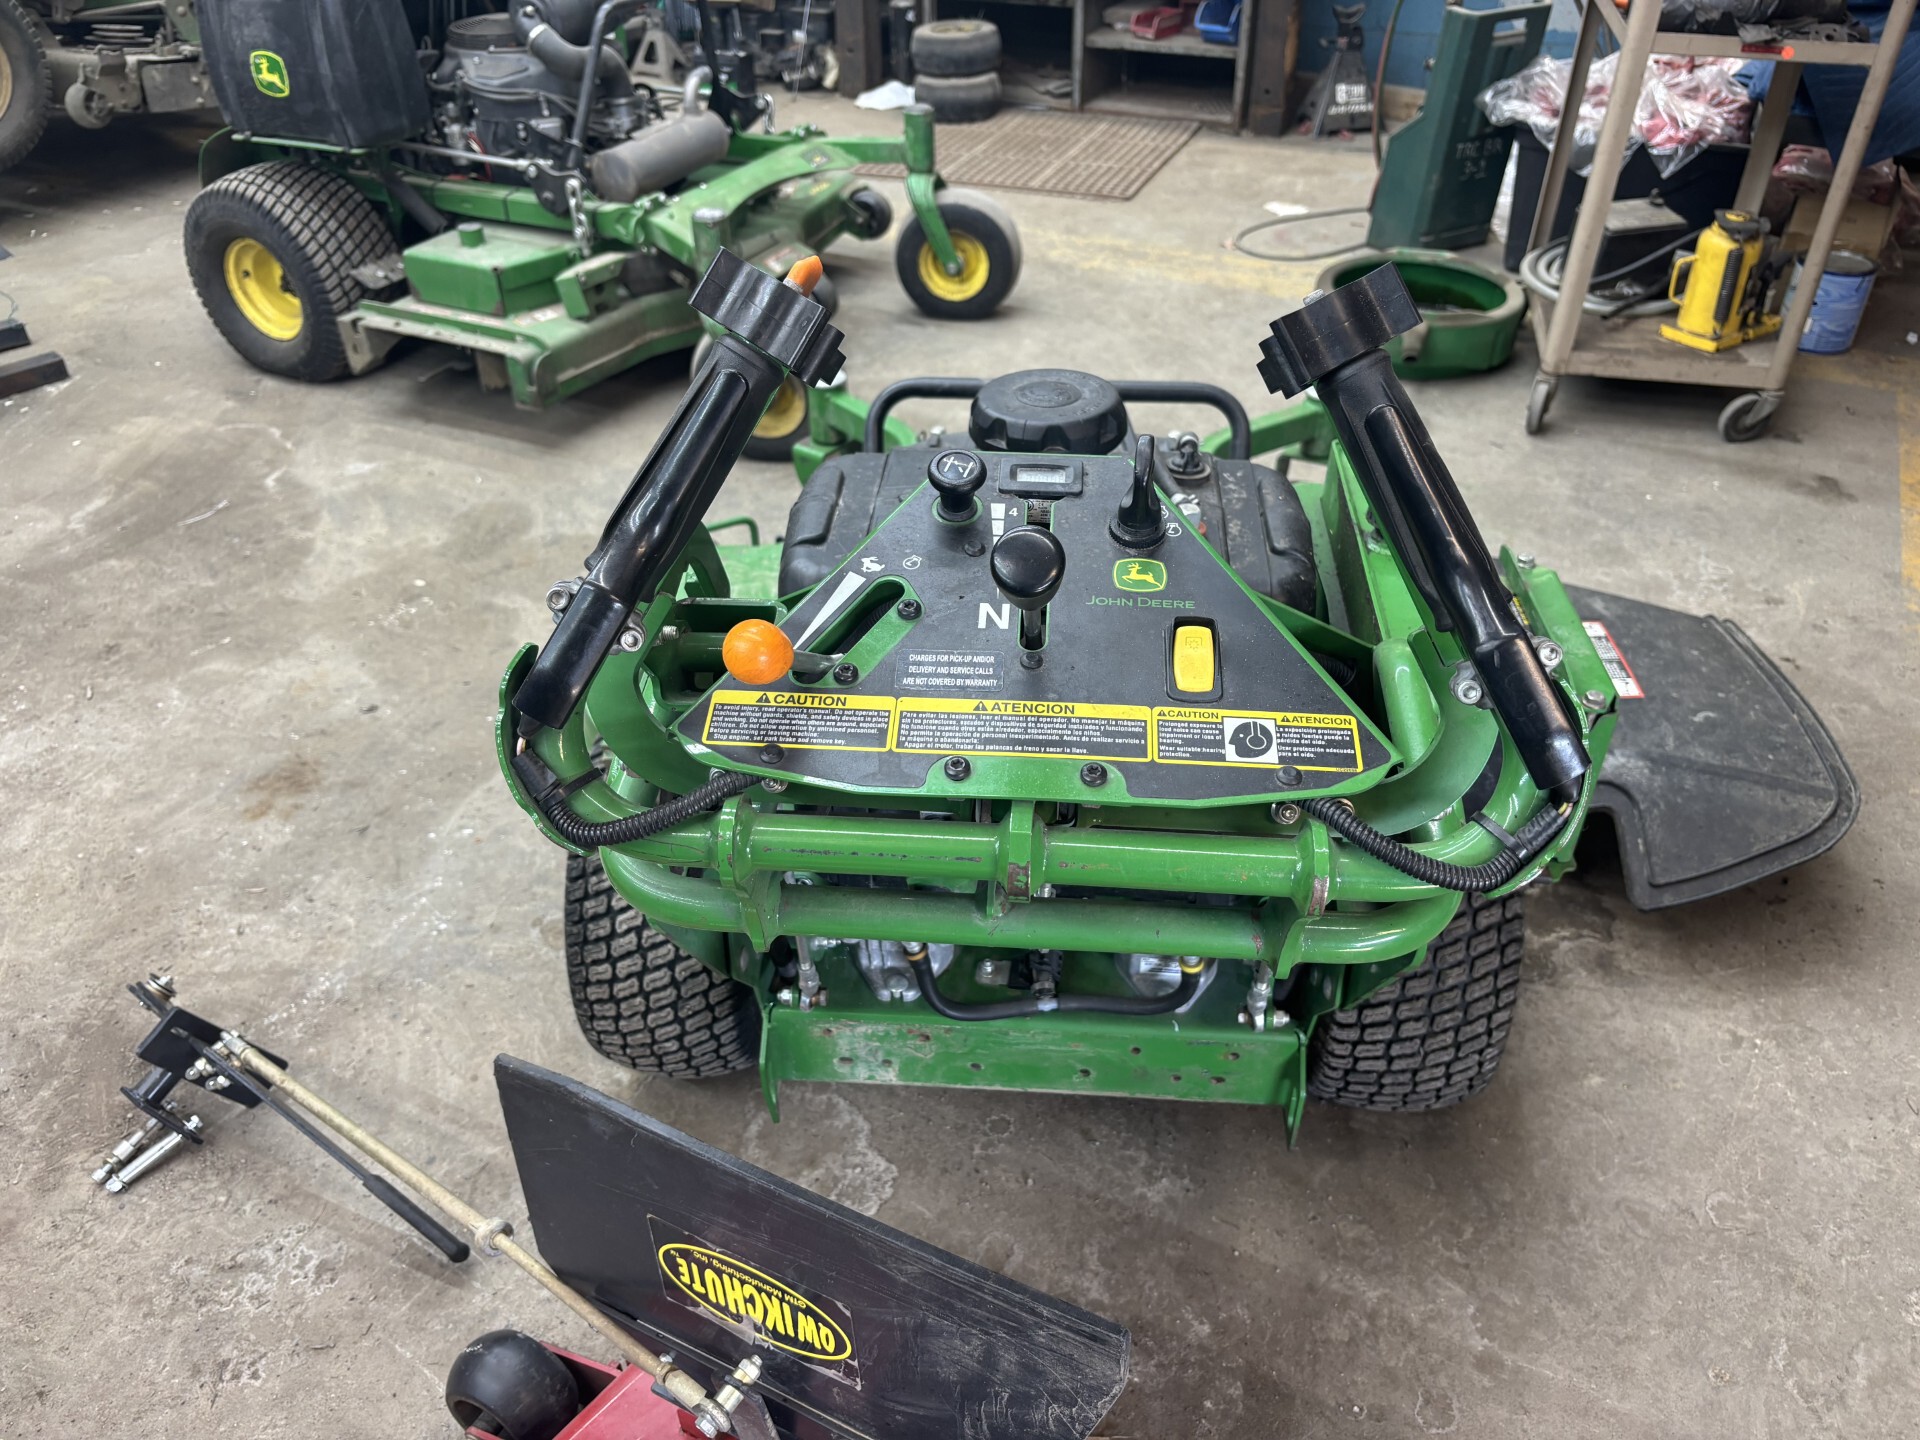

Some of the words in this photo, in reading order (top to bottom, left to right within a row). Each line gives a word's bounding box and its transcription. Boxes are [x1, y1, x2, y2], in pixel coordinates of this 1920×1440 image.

[1009, 507, 1018, 516] 4
[1086, 595, 1133, 606] JOHN
[1138, 597, 1195, 608] DEERE
[978, 602, 1011, 629] N
[909, 653, 937, 662] CHARGES
[937, 654, 949, 662] FOR
[950, 654, 972, 663] PICK-UP
[908, 665, 935, 673] DELIVERY
[936, 666, 949, 674] AND
[950, 666, 974, 674] SERVICE
[974, 667, 993, 675] CALLS
[902, 677, 914, 685] ARE
[915, 677, 928, 685] NOT
[928, 678, 955, 686] COVERED
[956, 678, 965, 686] BY
[965, 679, 998, 687] WARRANTY
[774, 694, 847, 706] CAUTION
[991, 703, 1075, 714] ATENCION
[856, 710, 878, 718] operate
[1168, 710, 1219, 719] CAUTION
[1291, 716, 1351, 725] ATENCION
[859, 722, 888, 730] especially
[690, 1250, 708, 1264] Inc.
[710, 1258, 782, 1298] Manufacturing,
[676, 1257, 836, 1354] QWIKCHUTE
[785, 1294, 806, 1308] GTM
